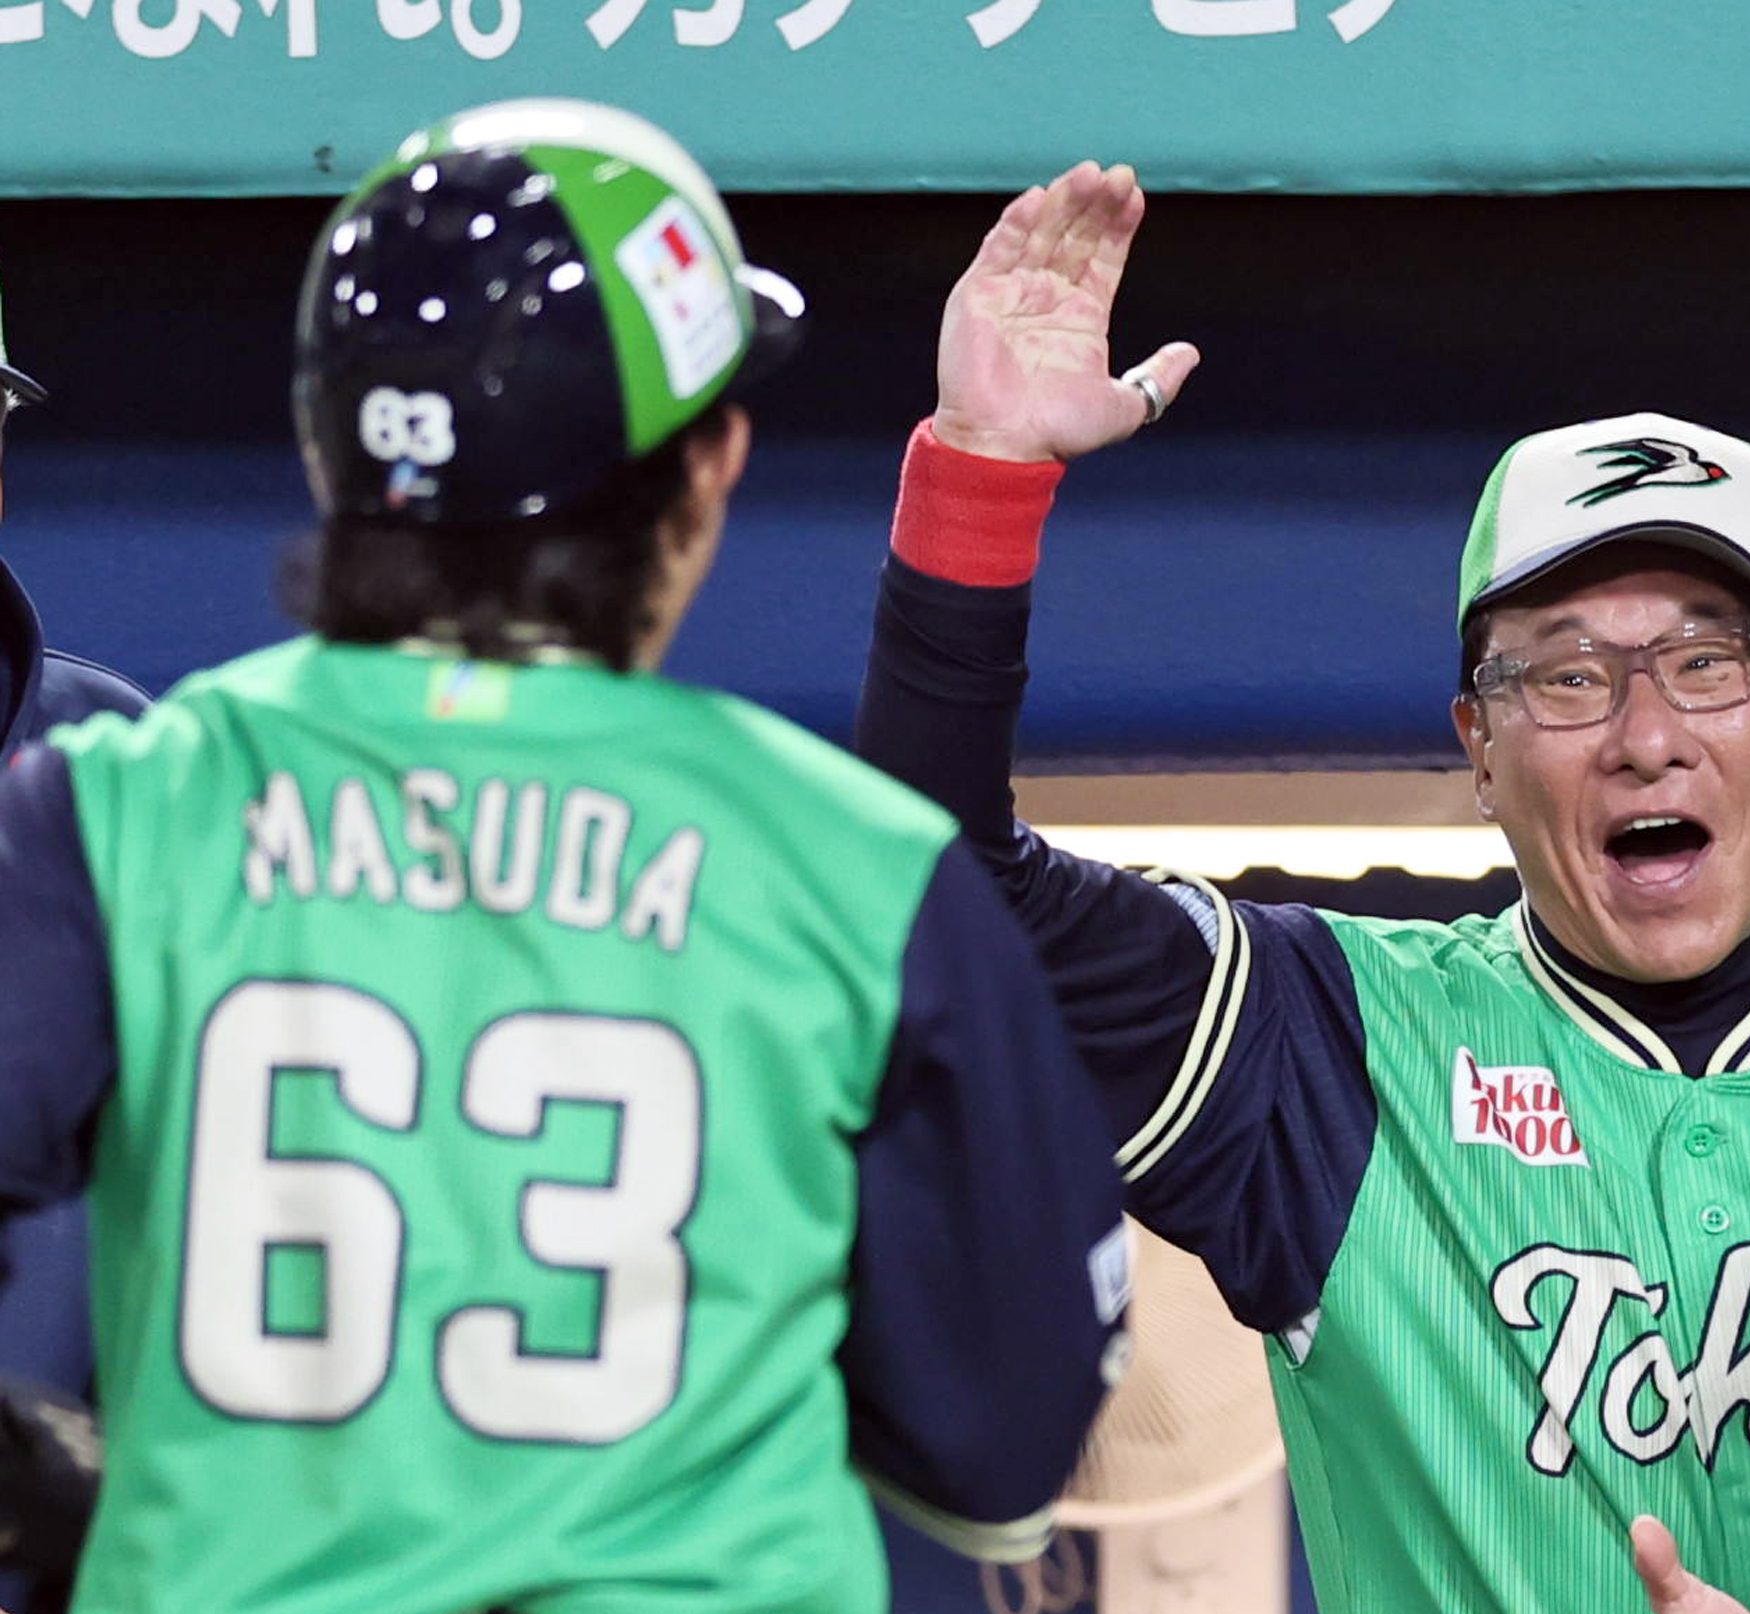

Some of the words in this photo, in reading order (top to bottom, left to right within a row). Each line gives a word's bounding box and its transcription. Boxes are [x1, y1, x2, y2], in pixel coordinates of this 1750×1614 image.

[359, 386, 456, 467] 63
[245, 766, 706, 953] MASUDA
[175, 974, 706, 1448] 63
